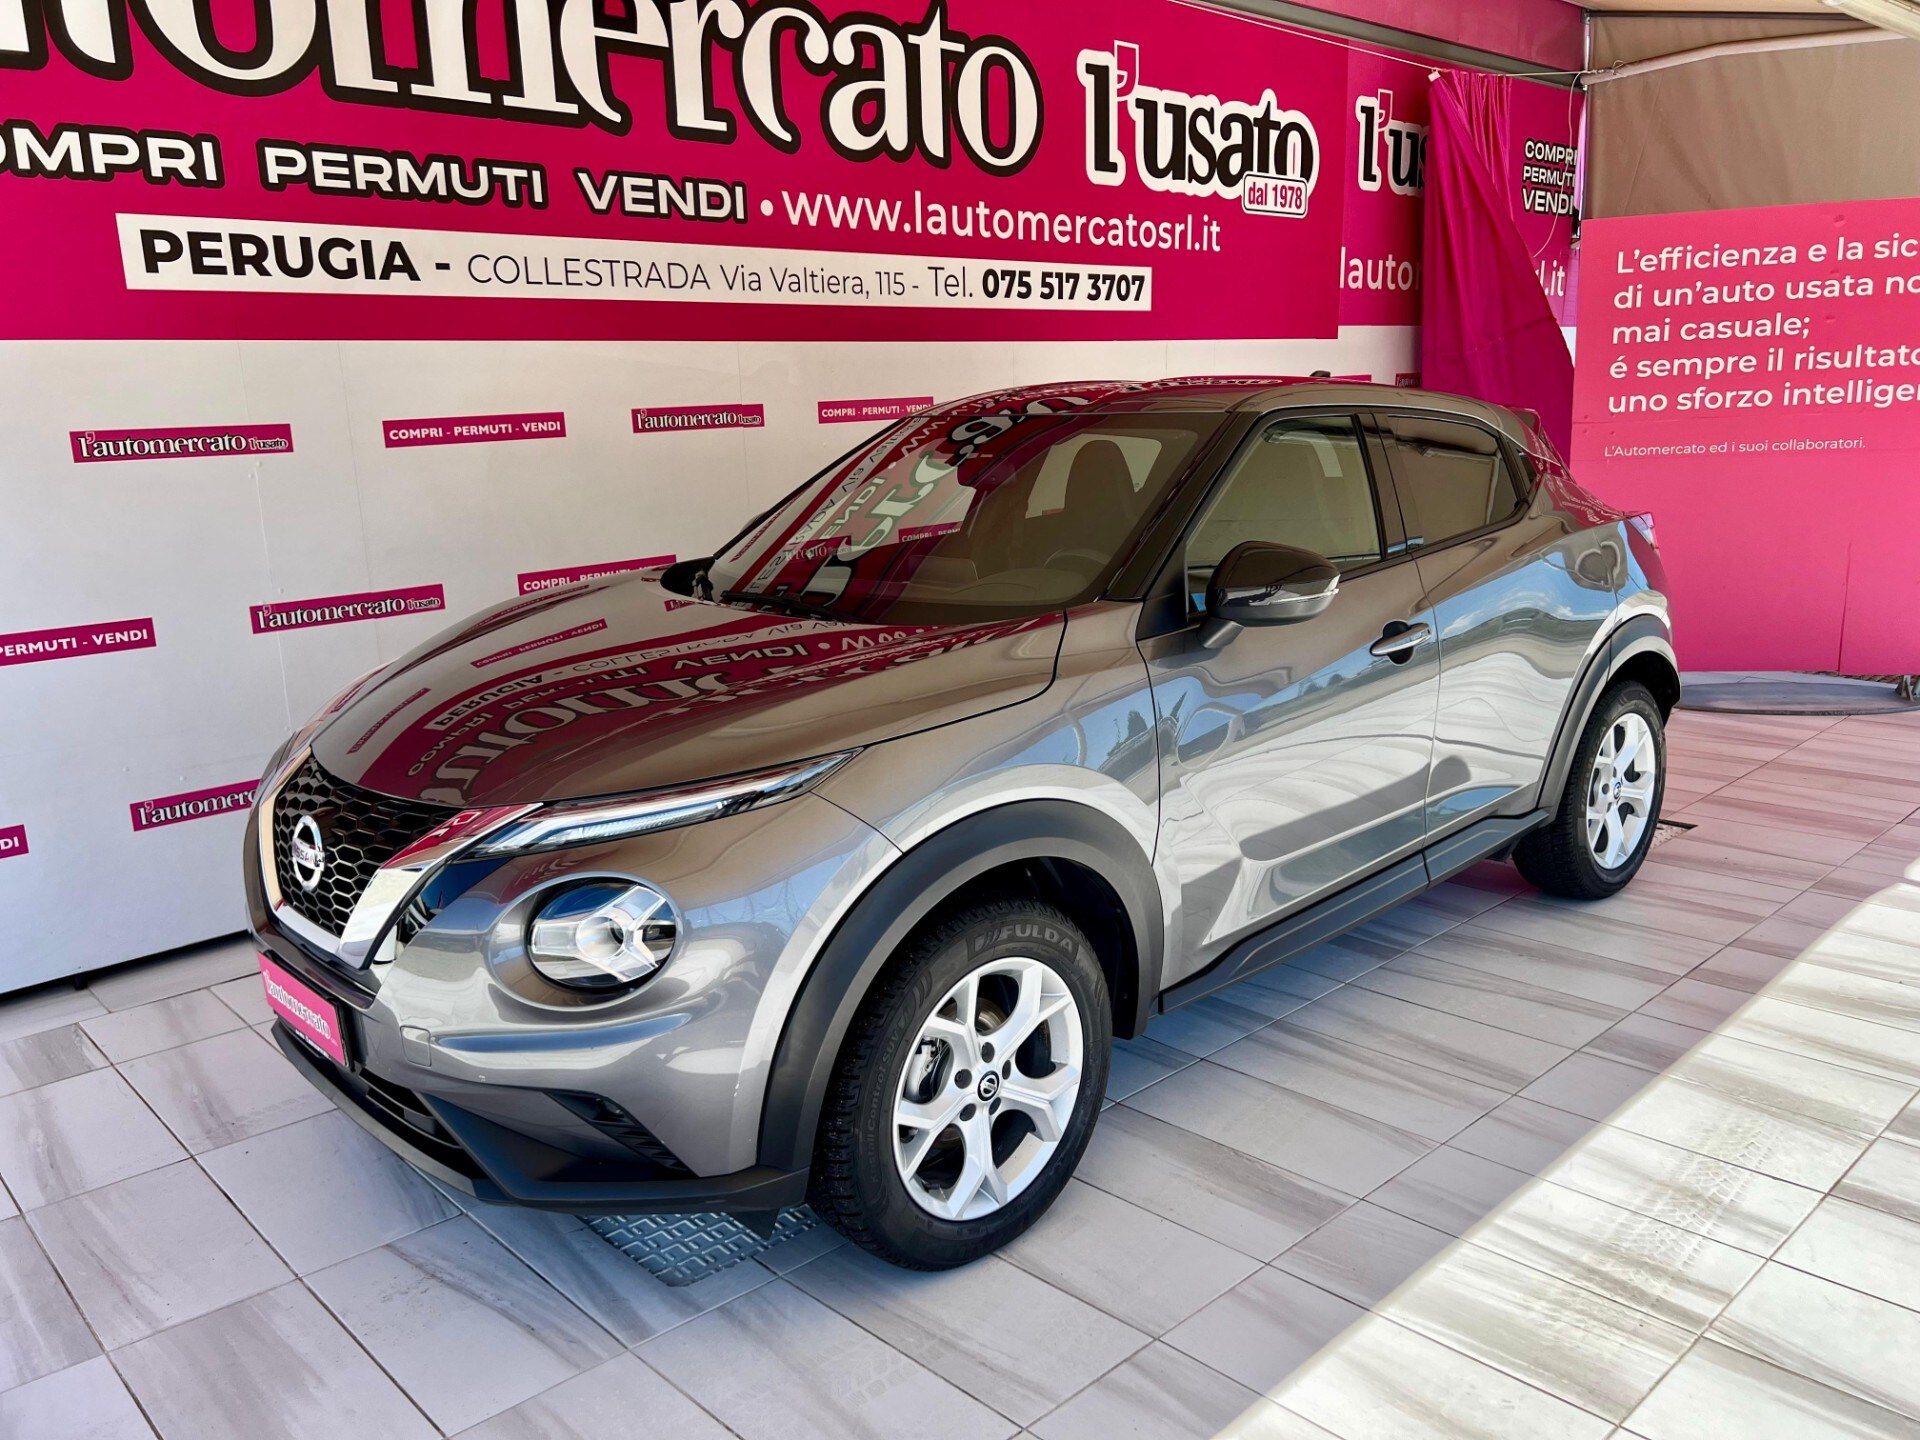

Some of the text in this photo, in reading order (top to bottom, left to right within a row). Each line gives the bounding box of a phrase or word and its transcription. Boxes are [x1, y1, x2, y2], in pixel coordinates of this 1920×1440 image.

[264, 146, 544, 203] PERMUTI
[577, 172, 745, 219] VENDI
[781, 190, 1221, 252] www.lautomercatosrl.it
[1248, 182, 1303, 209] dal 1978
[1522, 188, 1574, 215] VENDI
[140, 229, 421, 281] PERUGIA
[468, 253, 711, 291] COLLESTRADA
[720, 265, 762, 292] Via
[768, 267, 870, 300] Valtiera,
[876, 271, 906, 295] 115
[928, 267, 974, 298] Tel.
[982, 269, 1032, 299] 075
[1040, 271, 1081, 300] 517
[1087, 274, 1145, 302] 3707
[1616, 244, 1797, 274] L'efficienza
[1808, 244, 1827, 263] e
[1837, 236, 1863, 261] la
[1613, 284, 1643, 309] di
[1653, 281, 1775, 307] un'auto
[1786, 274, 1874, 299] usata
[1612, 312, 1810, 344] mai casuale;
[1609, 355, 1628, 379] é
[1636, 354, 1757, 380] sempre
[1767, 348, 1784, 372] il
[822, 408, 856, 417] COMPRI
[863, 405, 900, 415] PERMUTI
[1608, 378, 1920, 414] uno sforzo intellige
[78, 431, 248, 459] l'automercato
[389, 427, 443, 441] COMPRI
[454, 424, 512, 437] PERMUTI
[522, 420, 562, 433] VENDI
[1604, 443, 1706, 457] L'Automercato
[1709, 442, 1728, 453] ed
[1738, 440, 1769, 452] suoi
[1771, 437, 1866, 451] collaboratori.
[92, 629, 148, 646] VENDI
[1000, 923, 1074, 953] FULDA
